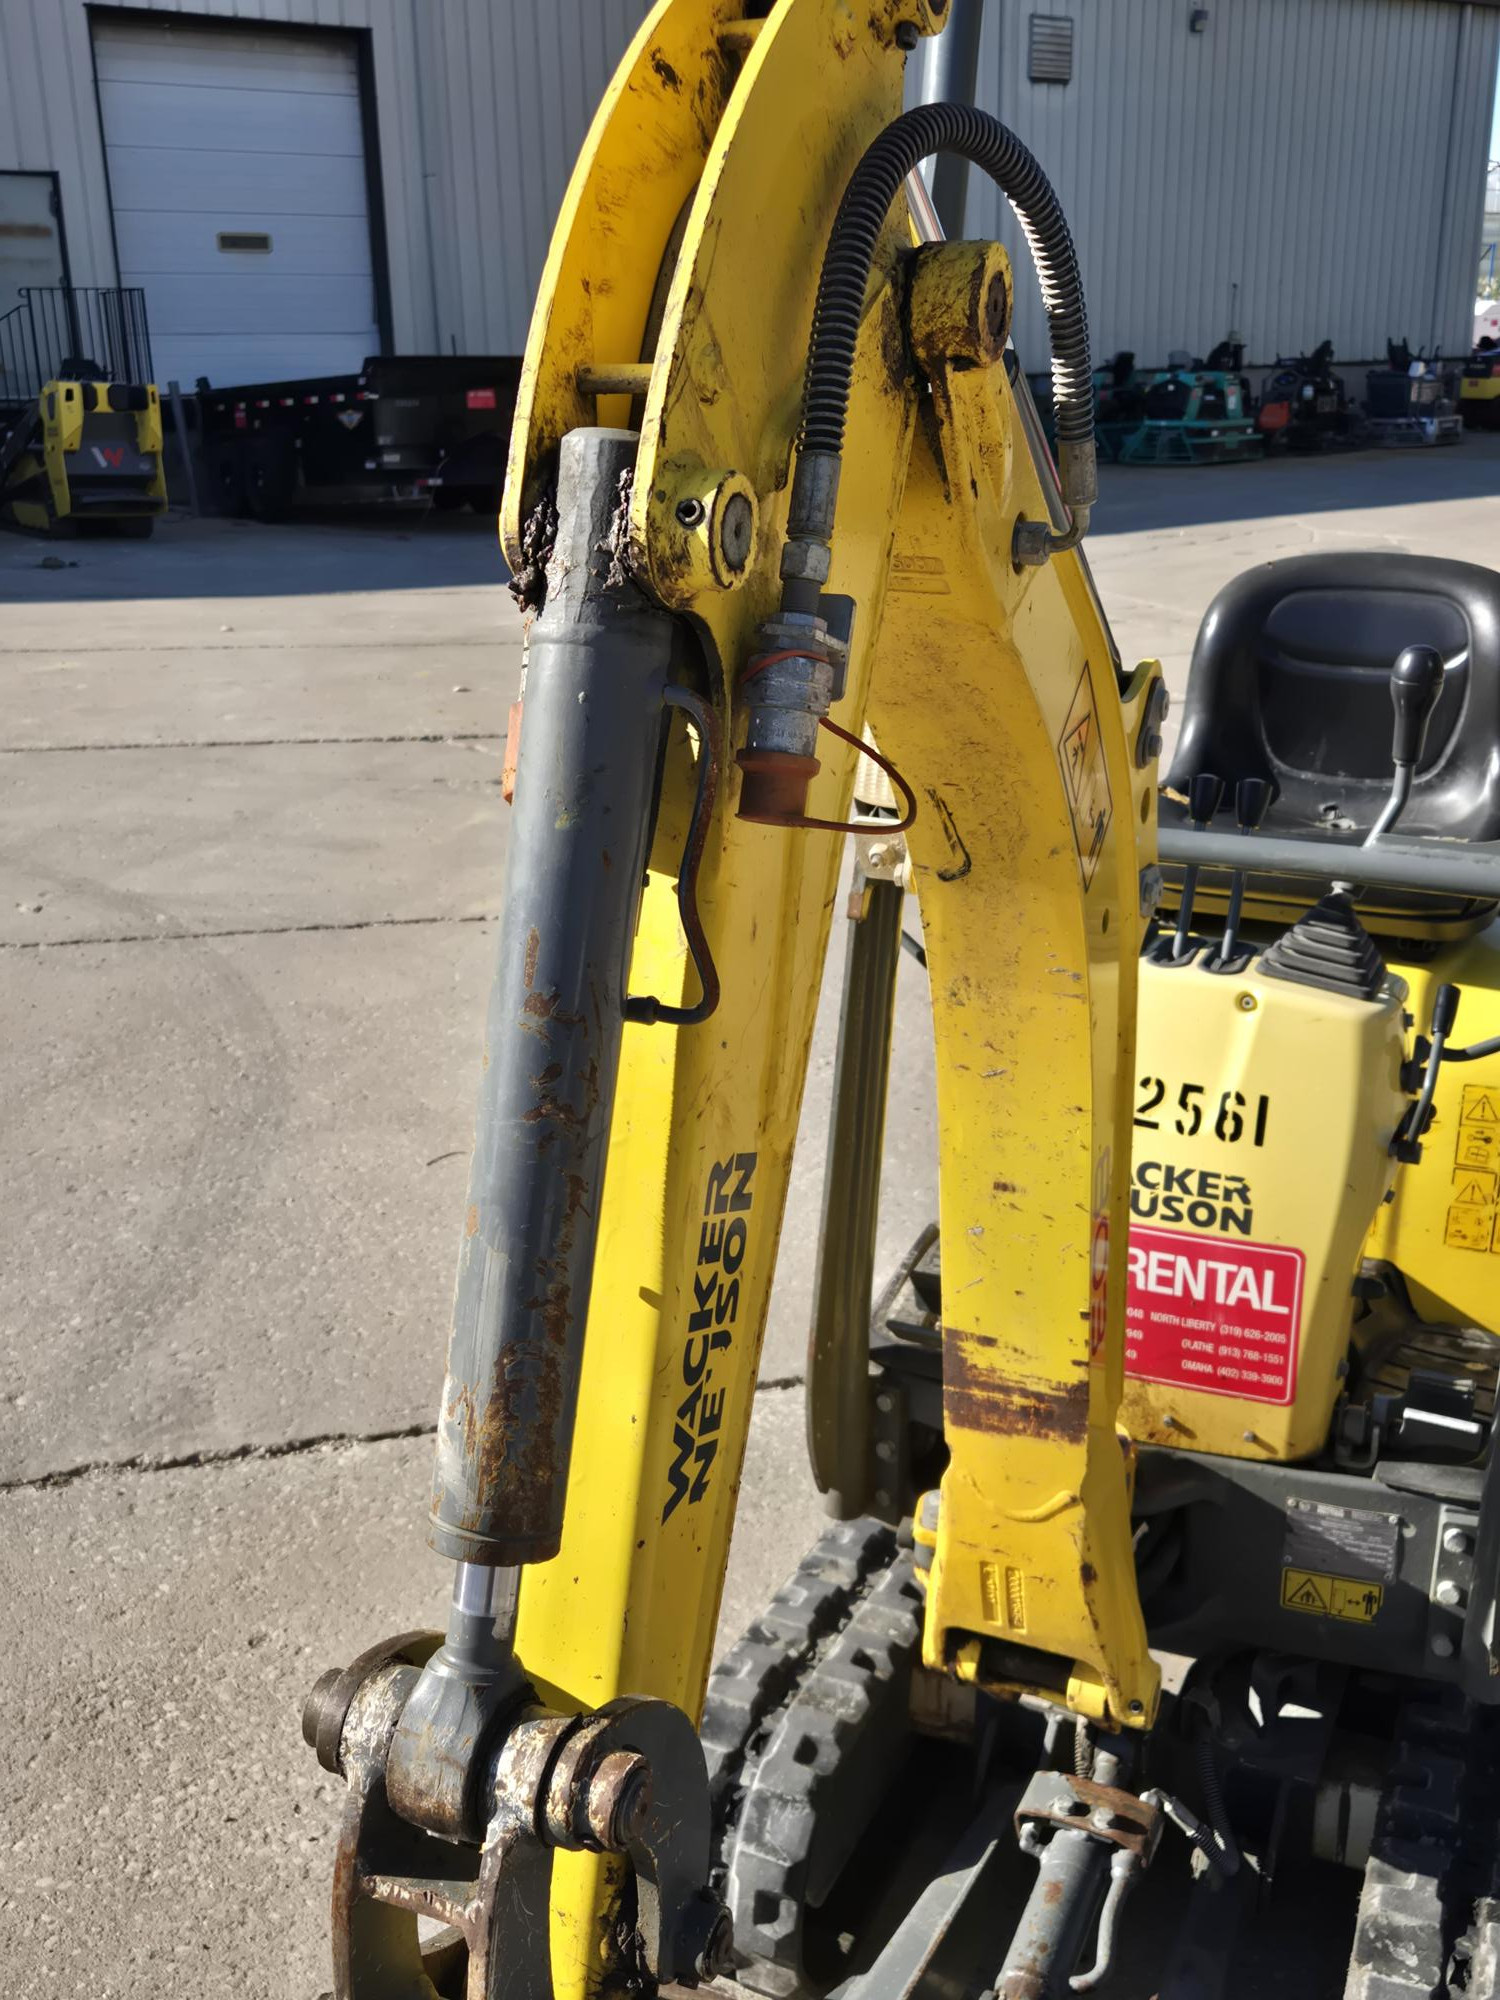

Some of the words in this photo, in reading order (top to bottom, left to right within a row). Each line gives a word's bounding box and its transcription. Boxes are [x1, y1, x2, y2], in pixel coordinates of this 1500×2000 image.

[1133, 1076, 1269, 1147] 2561
[1131, 1161, 1252, 1205] CKER
[1128, 1247, 1290, 1315] RENTAL
[661, 1153, 736, 1527] WACKER
[1150, 1312, 1180, 1325] NORTH
[1181, 1317, 1216, 1332] LIBERTY
